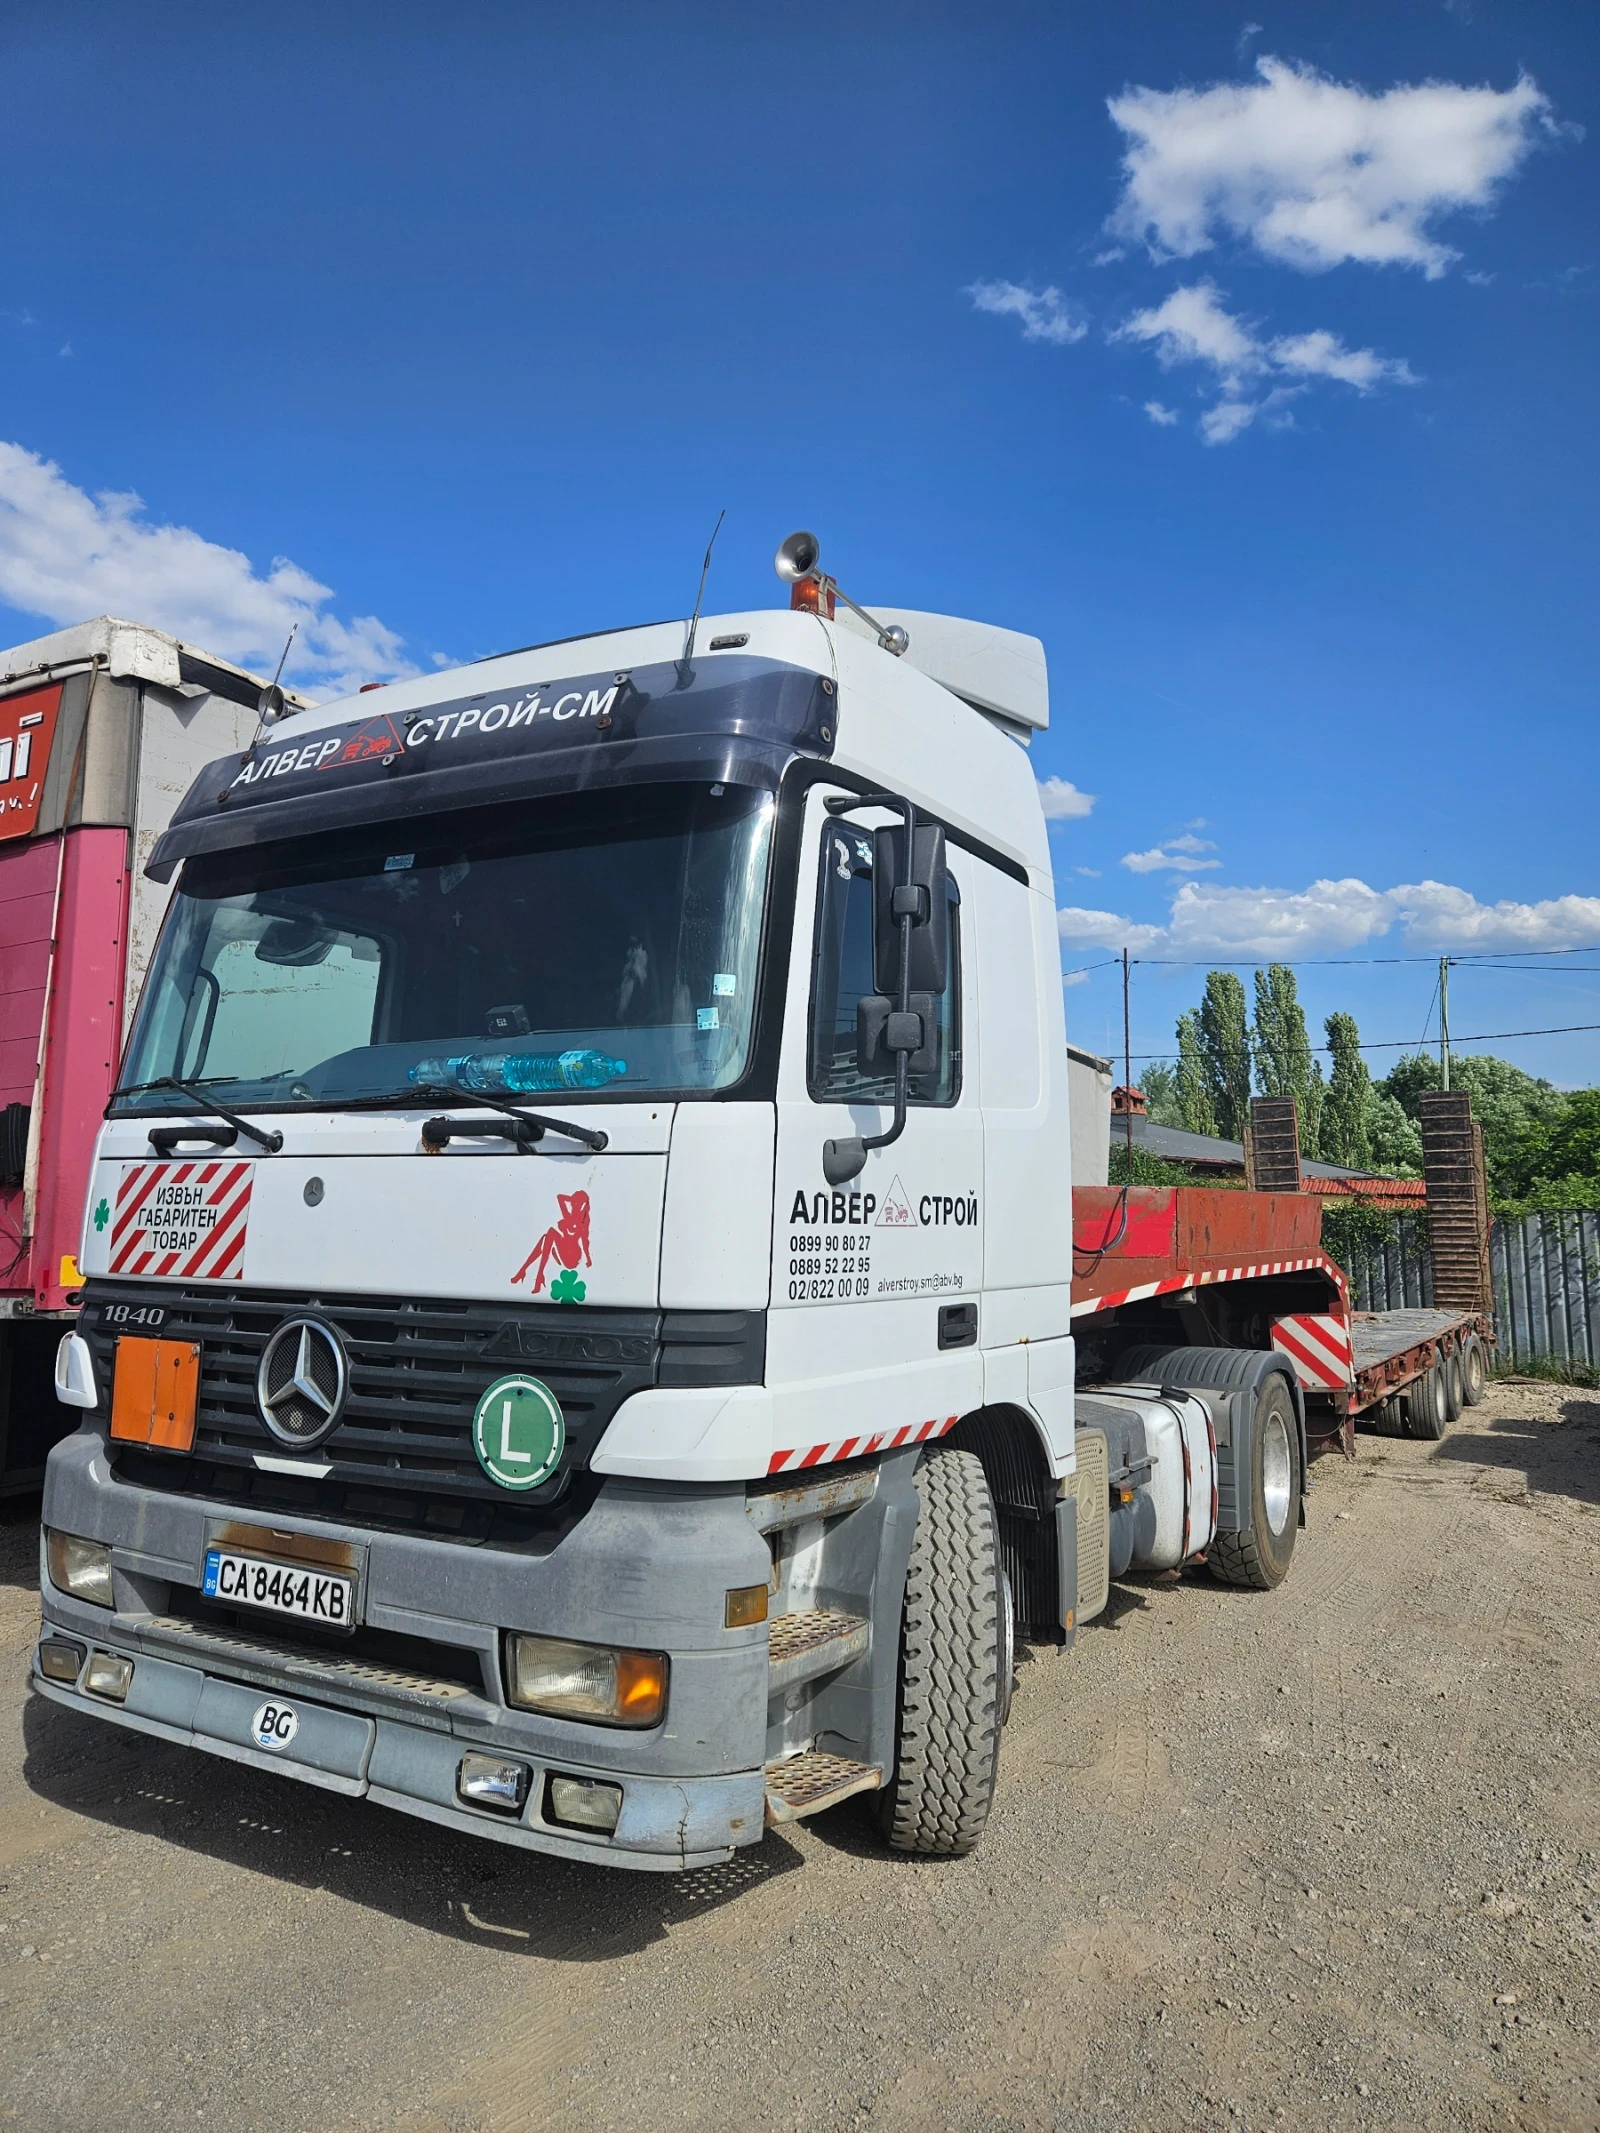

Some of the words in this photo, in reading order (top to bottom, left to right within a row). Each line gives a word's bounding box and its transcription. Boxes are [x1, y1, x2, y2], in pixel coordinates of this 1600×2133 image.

[230, 738, 342, 789] АЛВЕР
[405, 685, 620, 748] СТРОЙ-СМ
[156, 1187, 204, 1206] ИЗВЪН
[789, 1190, 877, 1225] АЛВЕР
[919, 1189, 978, 1226] СТРОЙ
[137, 1208, 218, 1228] ГАБАРИТЕН
[152, 1231, 198, 1250] ТОВАР
[789, 1235, 822, 1252] 0899
[825, 1235, 839, 1251] 90
[842, 1235, 856, 1251] 80
[858, 1235, 871, 1251] 27
[789, 1258, 822, 1276] 0889
[824, 1258, 839, 1274] 52
[841, 1257, 855, 1273] 22
[858, 1257, 870, 1273] 95
[788, 1279, 834, 1300] 02/822
[838, 1278, 851, 1297] 00
[855, 1277, 870, 1296] 09
[877, 1273, 963, 1293] alverstroy.sm@abv.bg
[105, 1305, 165, 1325] 1840
[500, 1400, 532, 1464] L
[205, 1578, 217, 1590] BG
[259, 1706, 294, 1739] BG
